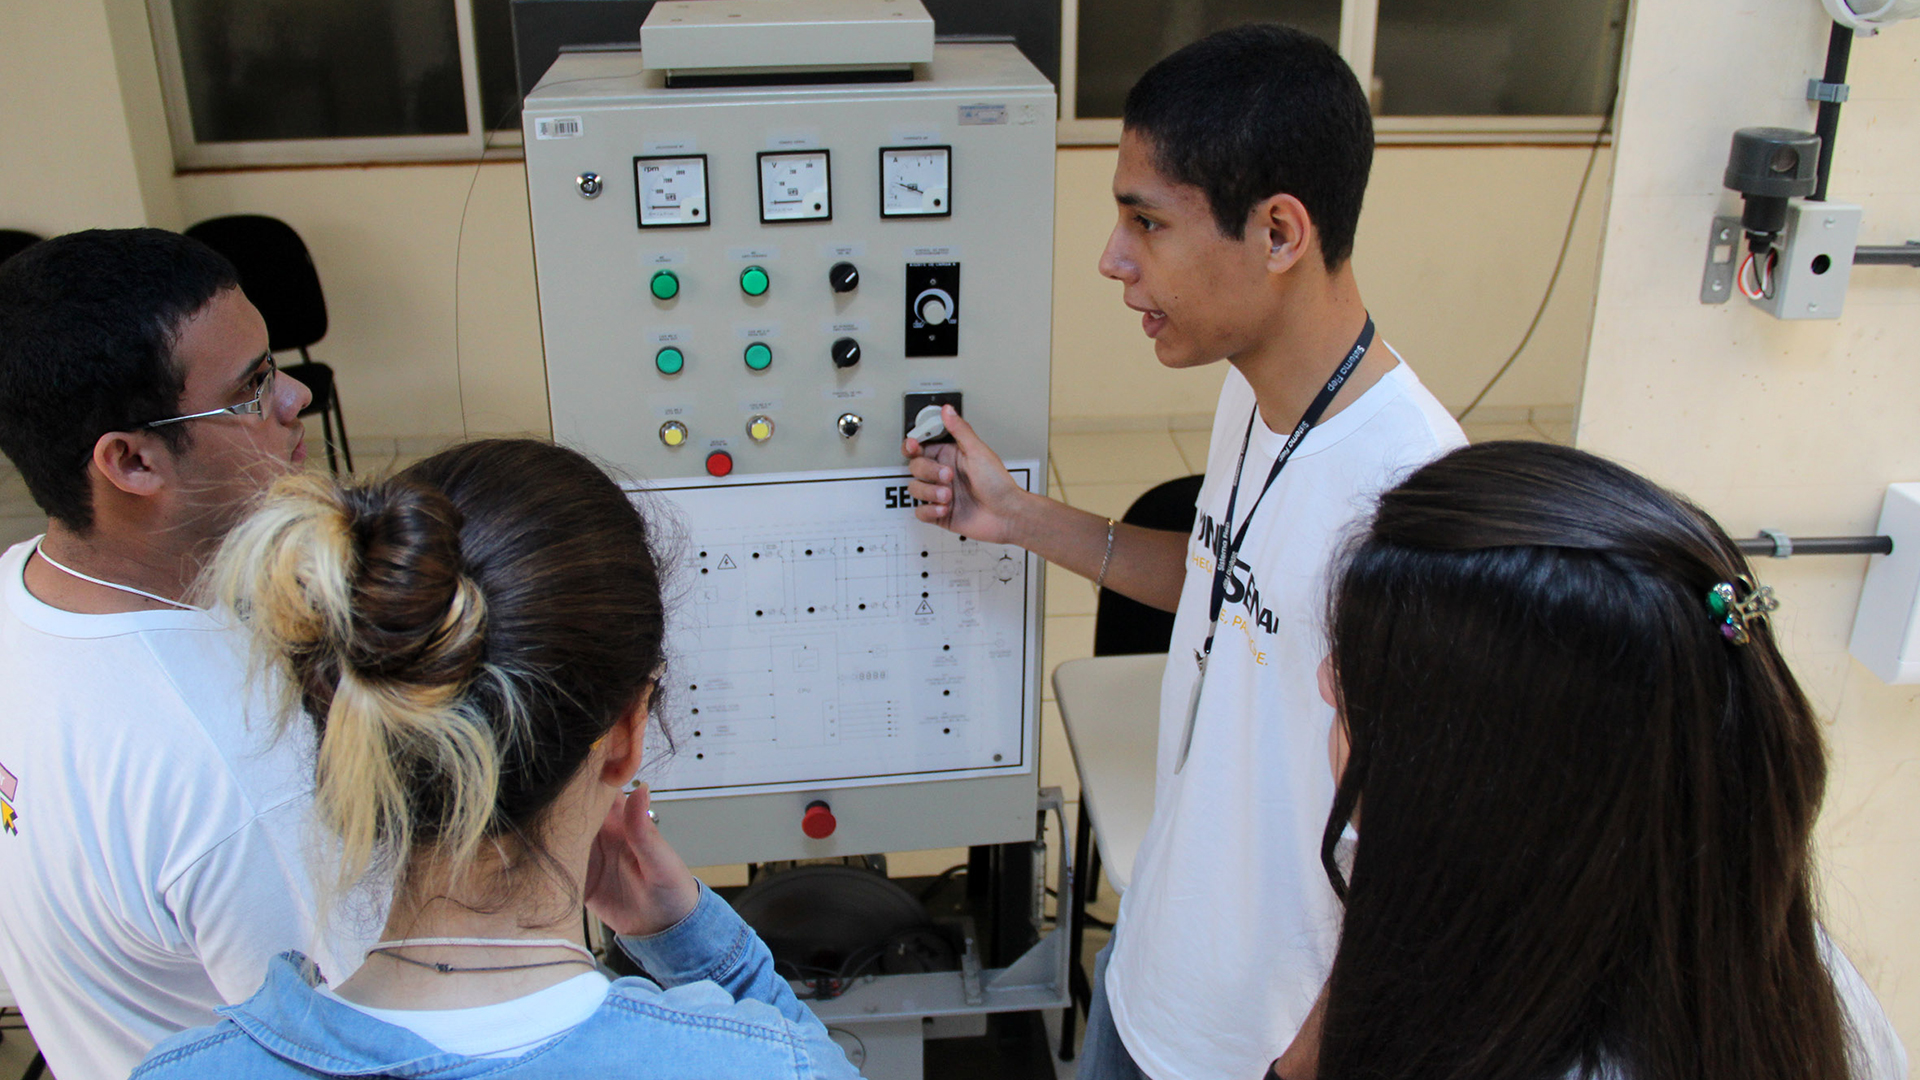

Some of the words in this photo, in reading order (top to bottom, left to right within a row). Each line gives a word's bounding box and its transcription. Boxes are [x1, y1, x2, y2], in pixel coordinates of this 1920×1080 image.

[1340, 344, 1365, 376] Sistema
[1287, 420, 1310, 448] Sistema
[1216, 540, 1229, 572] Sistema
